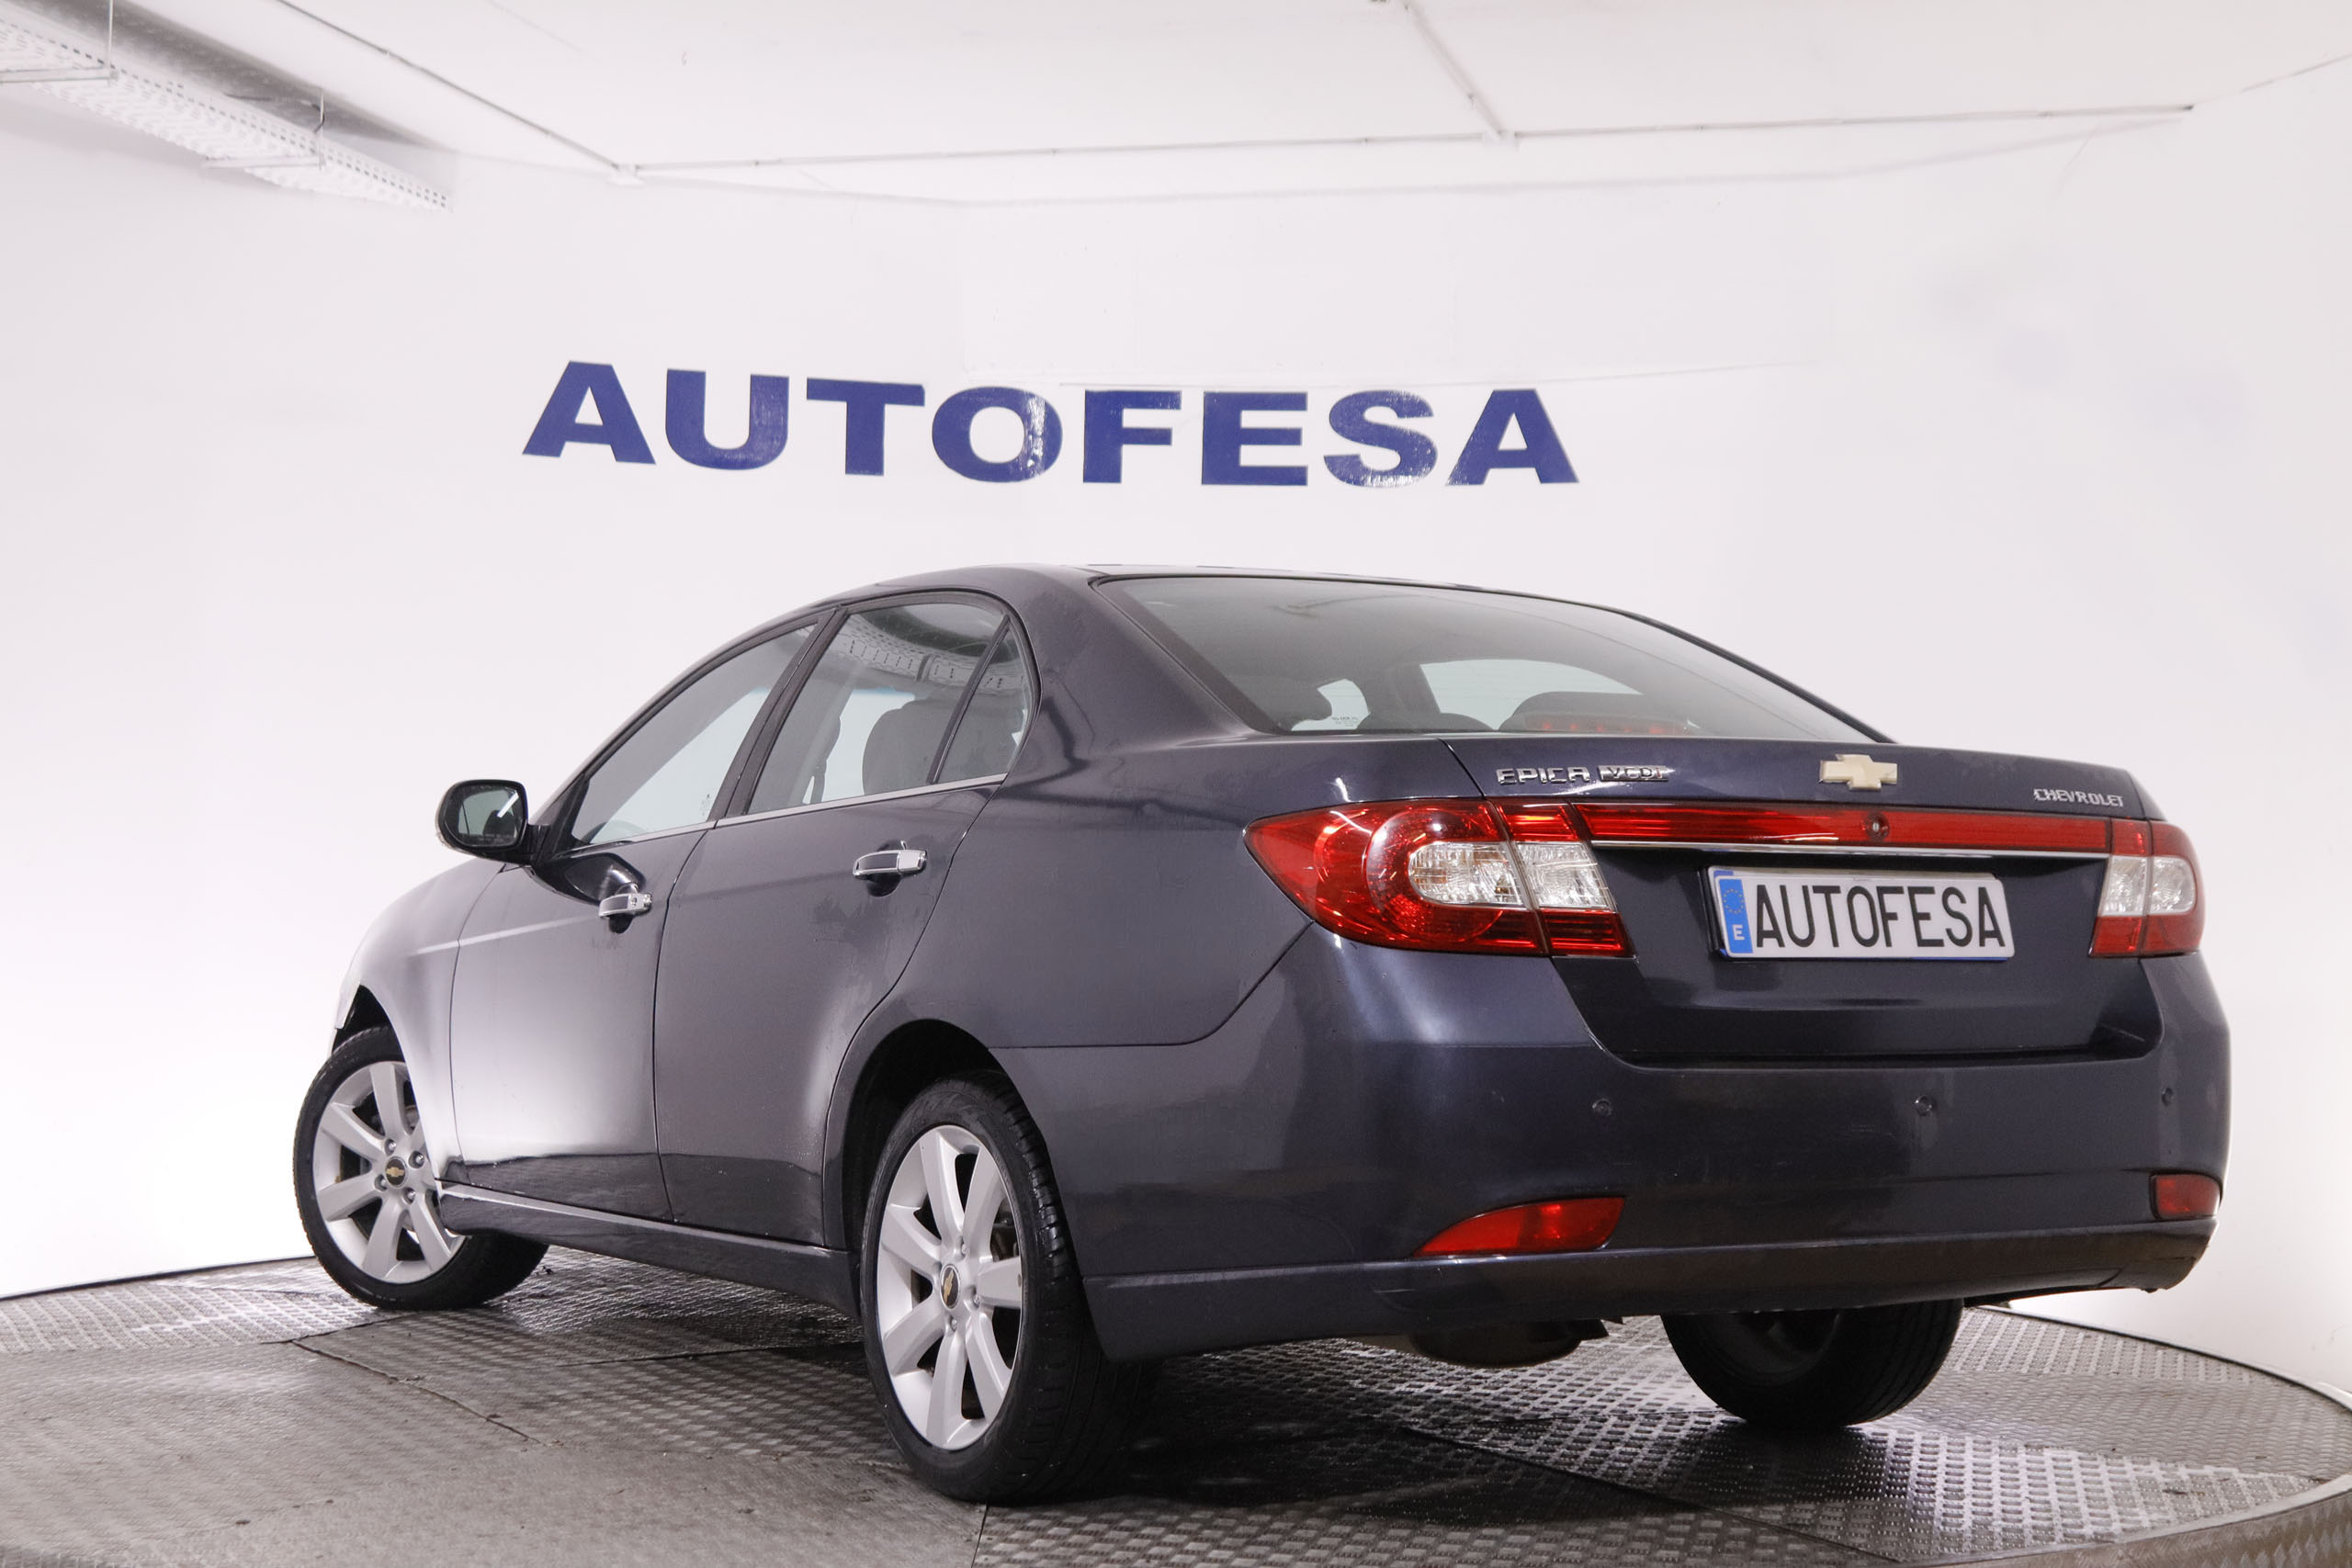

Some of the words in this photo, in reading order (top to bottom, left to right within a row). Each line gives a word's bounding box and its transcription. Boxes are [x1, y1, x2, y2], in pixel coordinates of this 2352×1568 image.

[525, 362, 1578, 485] AUTOFESA
[1496, 766, 1590, 784] EPICA
[2032, 788, 2124, 807] CHEVROLET
[1756, 884, 2006, 948] AUTOFESA
[1733, 923, 1746, 942] E
